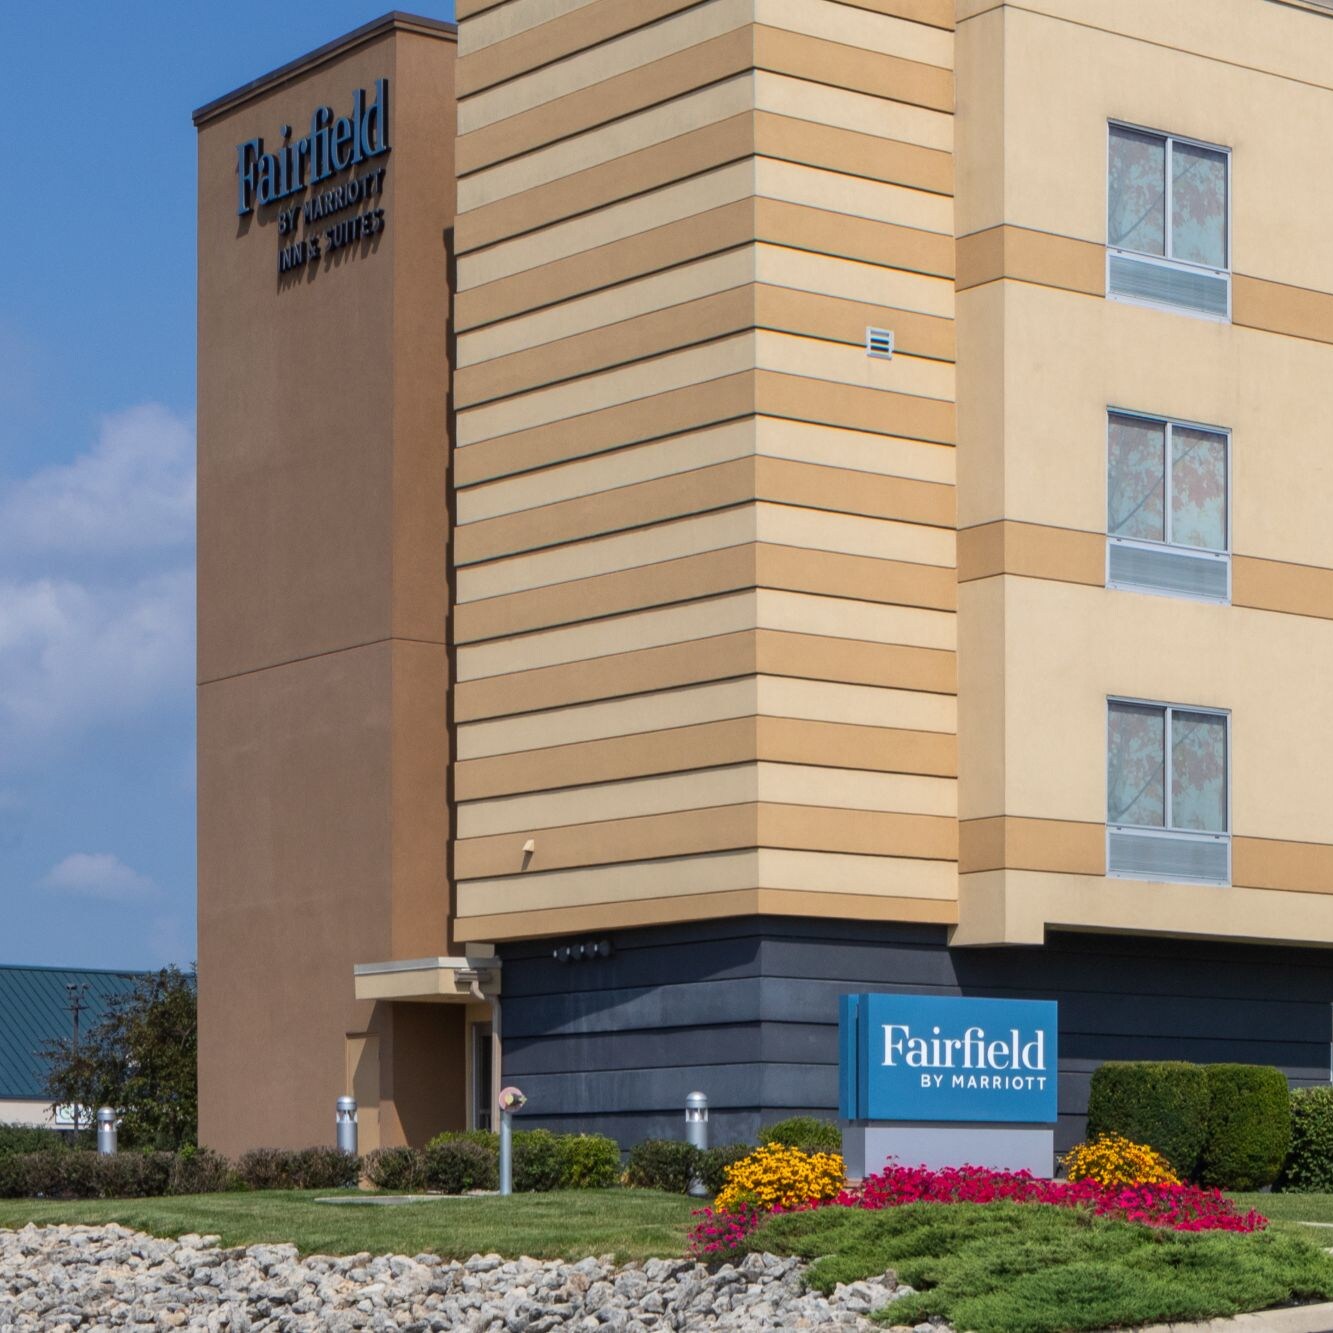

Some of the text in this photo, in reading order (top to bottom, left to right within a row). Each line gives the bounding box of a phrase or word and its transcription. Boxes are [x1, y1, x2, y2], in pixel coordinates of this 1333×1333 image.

[236, 77, 389, 216] Fairfield
[278, 167, 386, 236] BY MARRIOTT
[306, 232, 321, 259] &
[324, 207, 385, 252] SUITES
[881, 1024, 1047, 1070] Fairfield
[921, 1074, 1047, 1090] BY MARRIOTT
